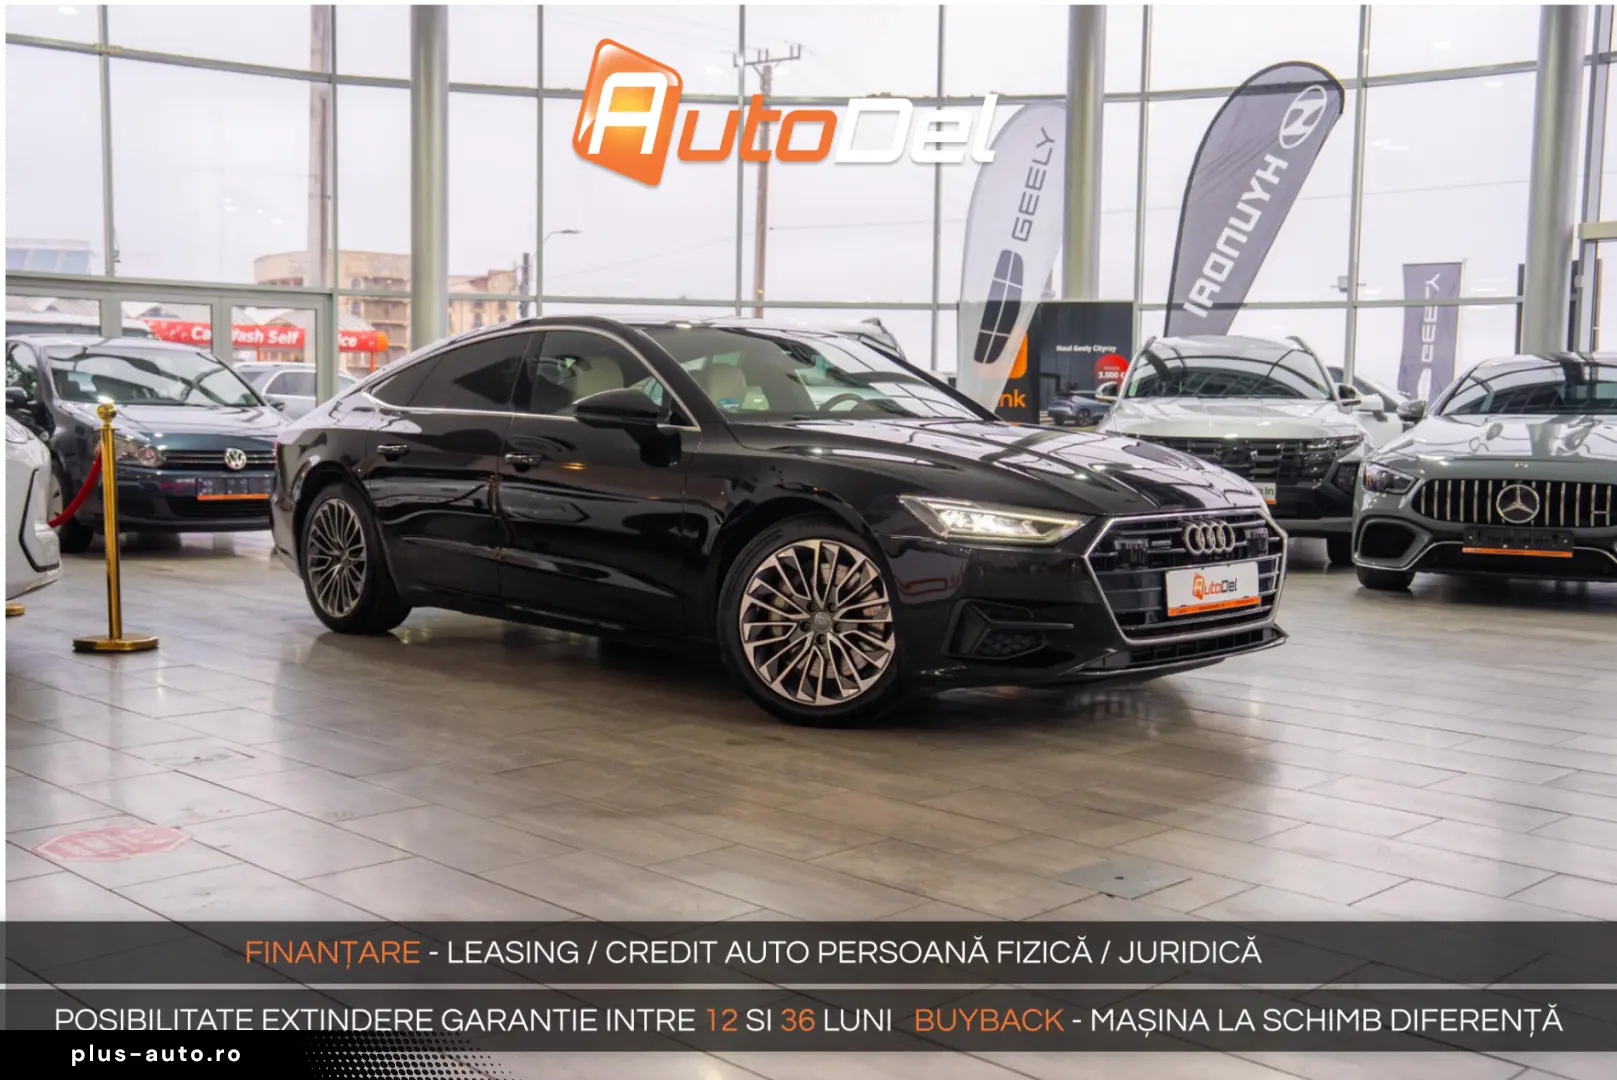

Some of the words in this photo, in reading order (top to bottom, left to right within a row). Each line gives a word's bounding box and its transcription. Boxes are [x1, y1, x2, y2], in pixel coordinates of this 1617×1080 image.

[1011, 126, 1055, 242] GEELY
[268, 330, 299, 345] Self
[1194, 577, 1238, 598] AutoDel
